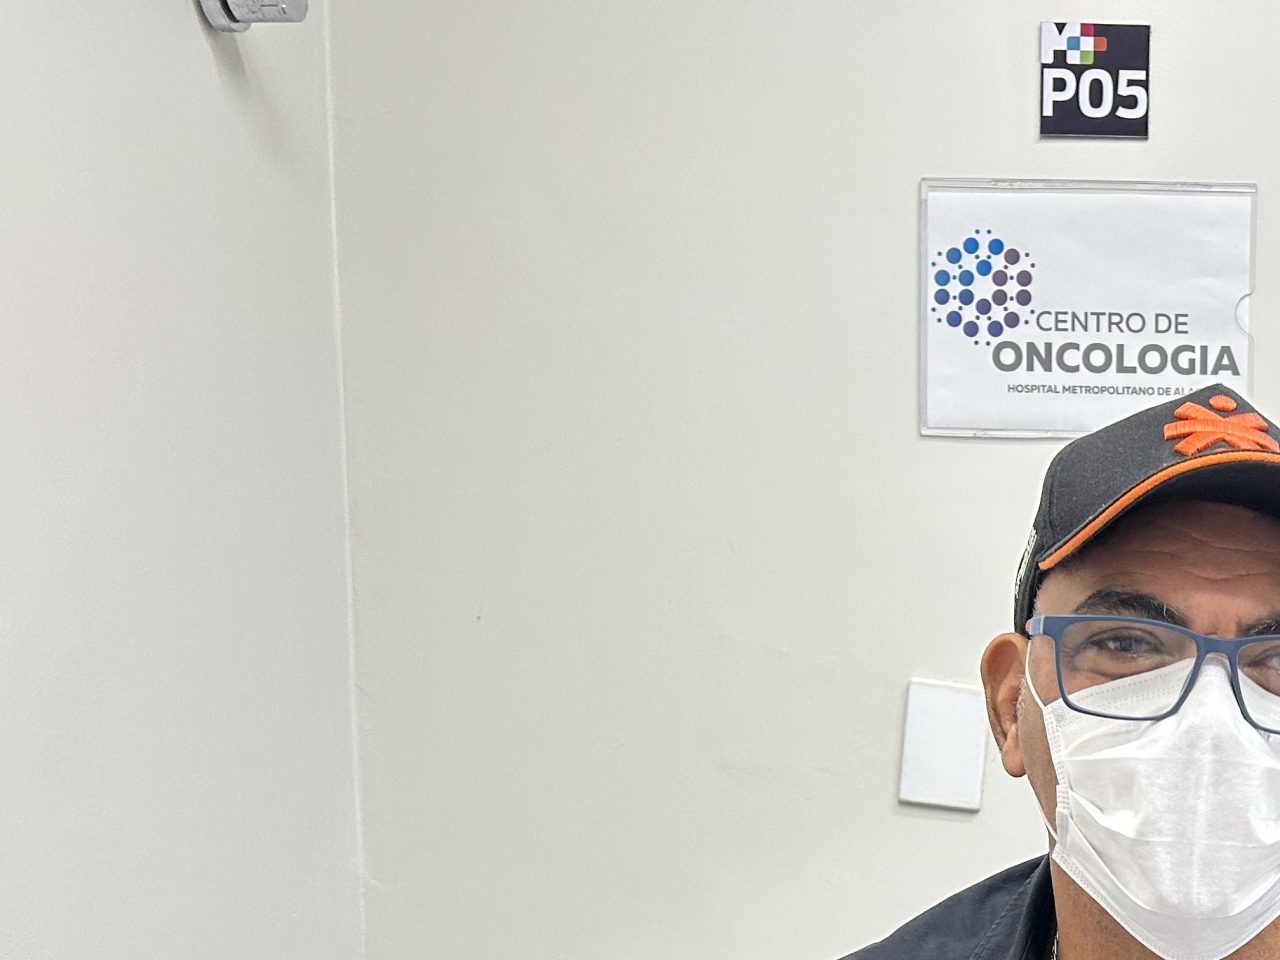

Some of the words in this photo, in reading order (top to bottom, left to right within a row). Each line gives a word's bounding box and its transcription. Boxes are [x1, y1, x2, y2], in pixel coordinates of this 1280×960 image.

[1042, 68, 1148, 119] P05
[1036, 311, 1146, 333] CENTRO
[1155, 313, 1189, 334] DE
[992, 341, 1241, 376] ONCOLOGIA
[1007, 384, 1060, 394] HOSPITAL
[1062, 385, 1155, 396] METROPOLITANO
[1157, 387, 1171, 396] DE
